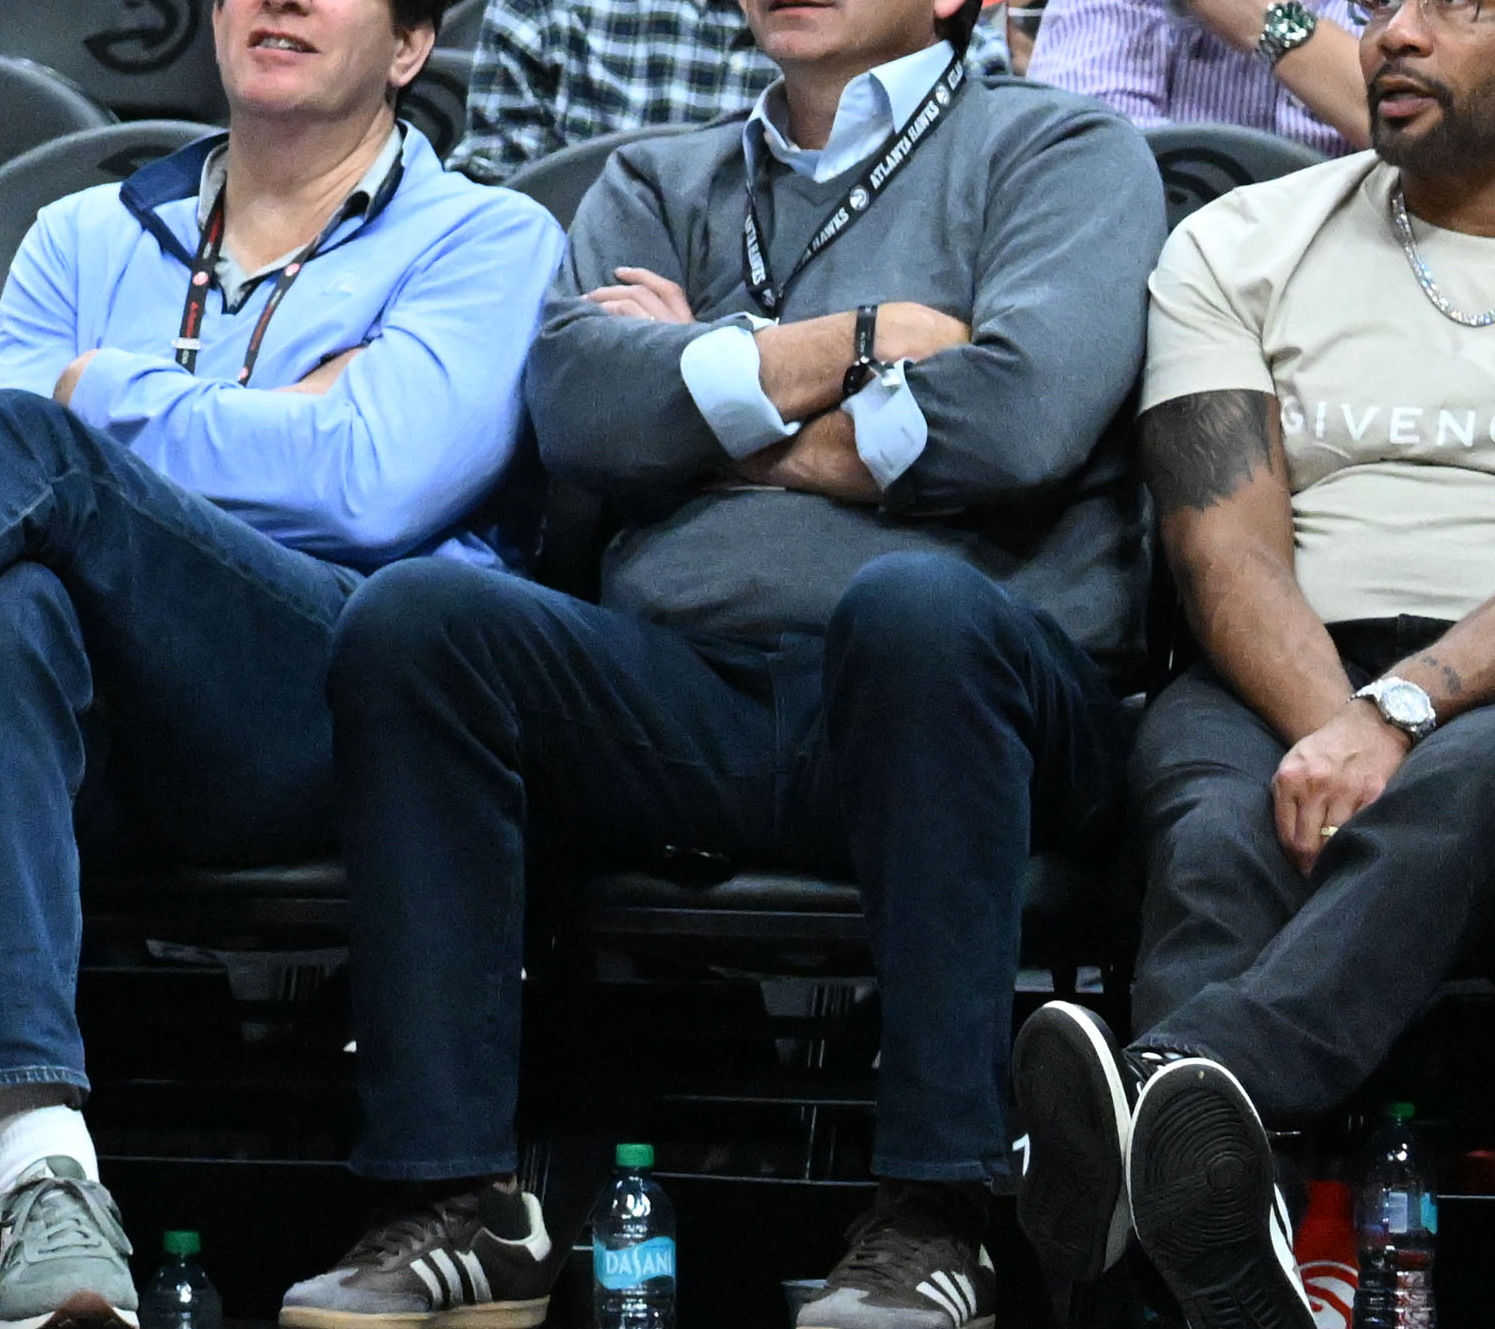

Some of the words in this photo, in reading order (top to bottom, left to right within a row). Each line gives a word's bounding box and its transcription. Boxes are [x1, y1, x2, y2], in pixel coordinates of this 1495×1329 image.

[869, 136, 912, 191] ATLANTA
[907, 100, 941, 144] HAWKS
[1281, 395, 1495, 447] GIVEN
[605, 1247, 673, 1282] DASANI
